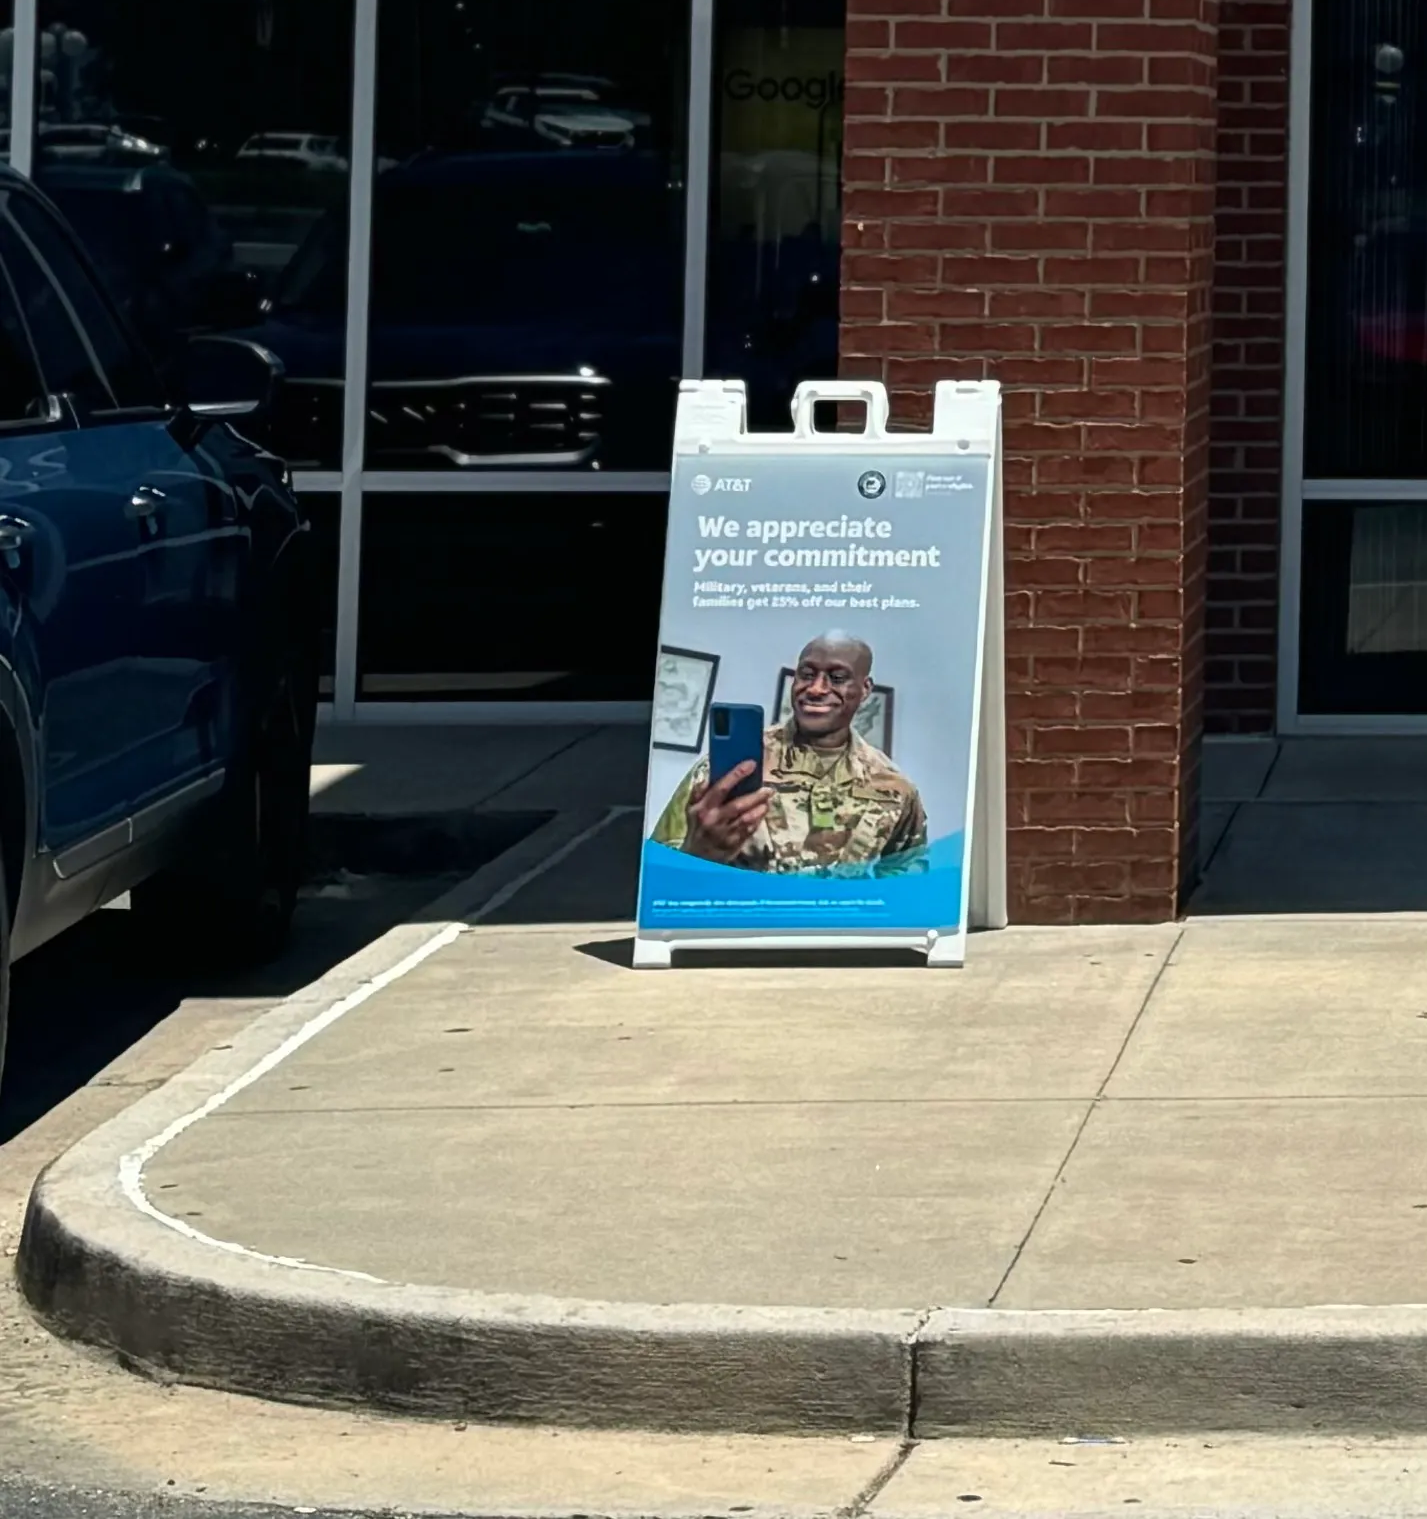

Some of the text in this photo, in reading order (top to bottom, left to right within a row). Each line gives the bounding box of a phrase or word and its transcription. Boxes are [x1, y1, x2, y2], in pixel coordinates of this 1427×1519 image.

[724, 69, 845, 109] Googl
[714, 478, 752, 492] AT&T
[698, 514, 892, 543] We appreciate
[693, 544, 941, 572] your commitment
[693, 580, 872, 596] Military, veterans, and their
[693, 595, 744, 608] families
[747, 597, 768, 610] get
[801, 595, 821, 608] off
[824, 598, 847, 608] our
[850, 595, 878, 608] best
[880, 595, 921, 610] plans.
